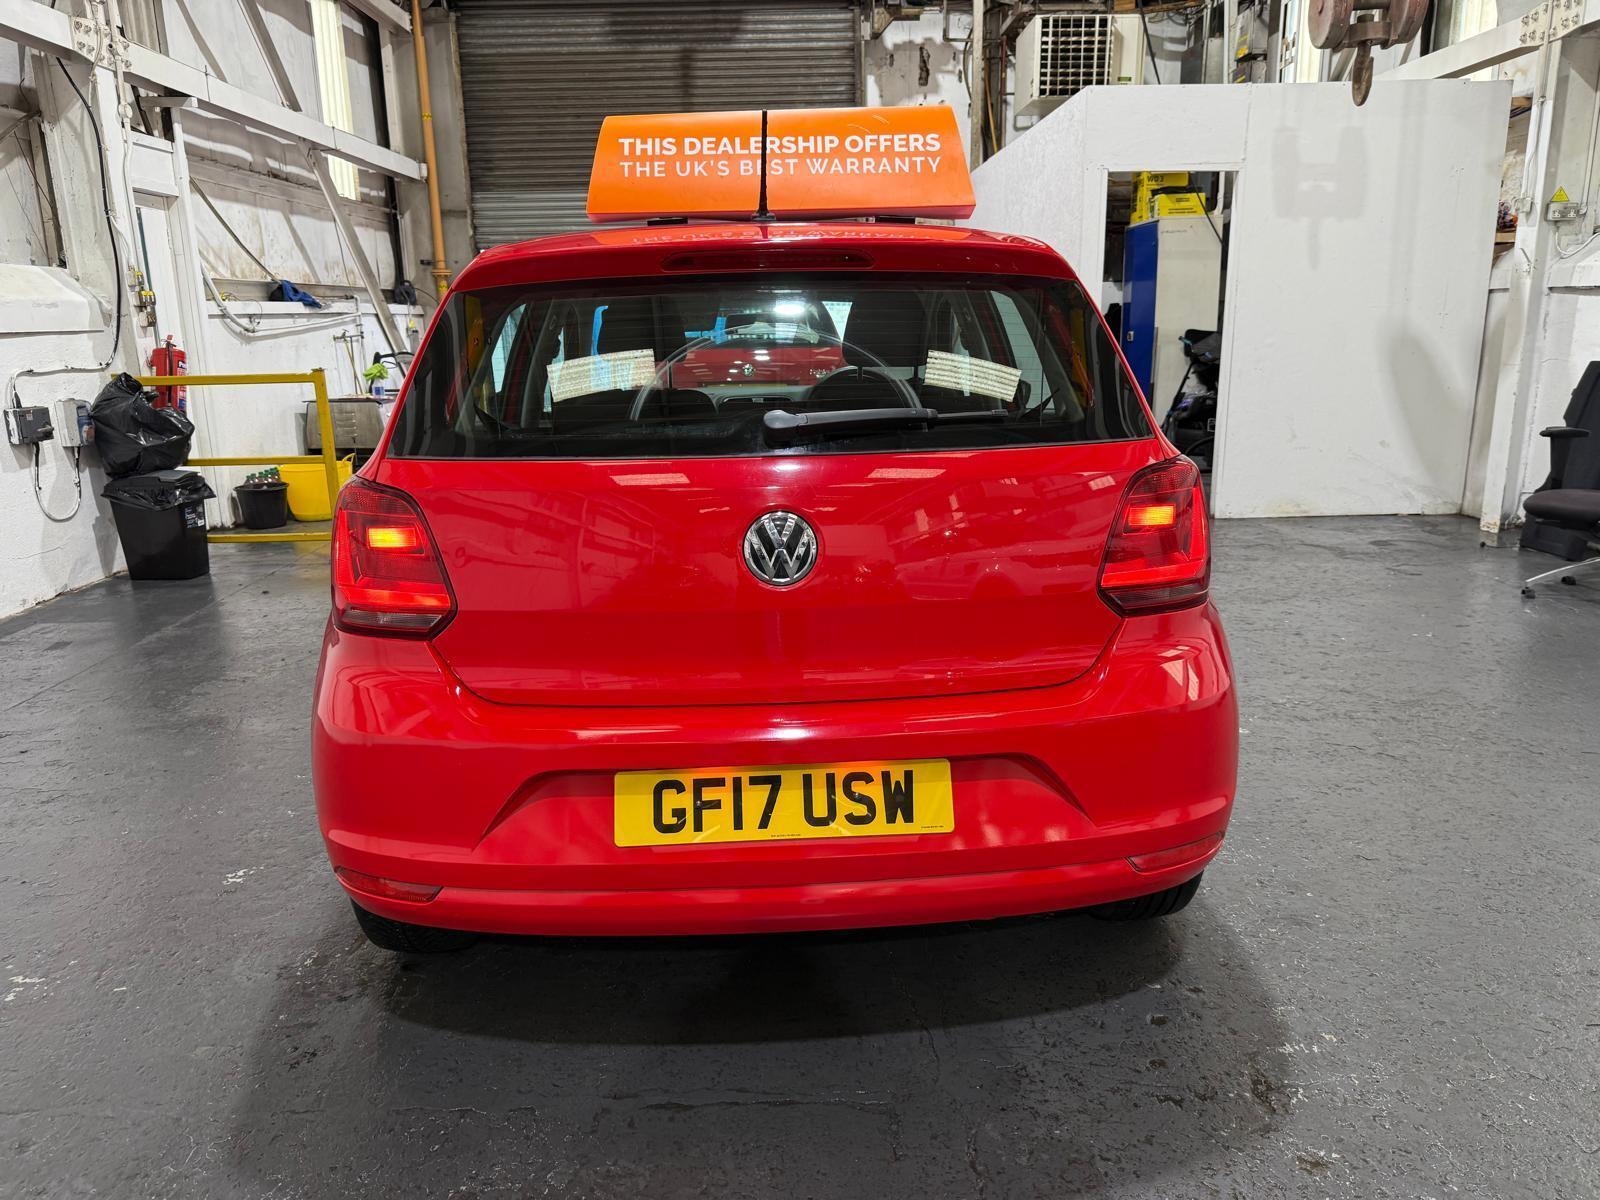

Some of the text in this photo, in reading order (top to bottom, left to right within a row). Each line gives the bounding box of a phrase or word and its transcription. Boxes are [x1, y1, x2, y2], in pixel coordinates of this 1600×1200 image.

[618, 133, 941, 156] THIS DEALERSHIP OFFERS
[619, 161, 666, 178] THE
[675, 160, 730, 177] UK'S
[806, 156, 941, 175] WARRANTY
[653, 769, 914, 834] GF17 USW
